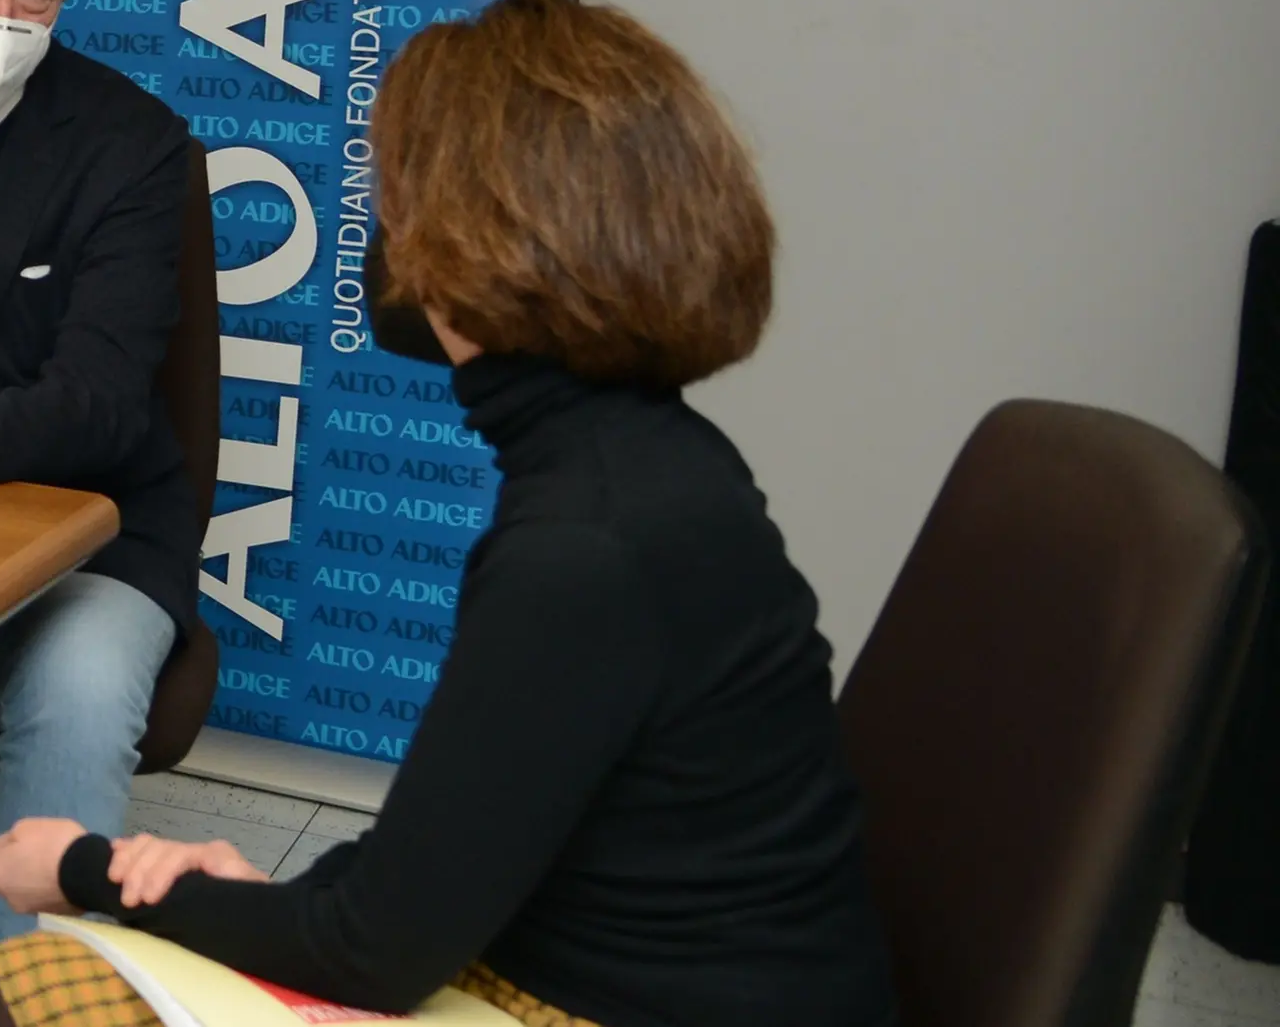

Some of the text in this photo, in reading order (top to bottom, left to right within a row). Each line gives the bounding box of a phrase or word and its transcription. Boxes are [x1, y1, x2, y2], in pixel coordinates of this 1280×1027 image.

[330, 140, 374, 354] QUOTIDIANO
[197, 145, 318, 642] ALTO
[324, 409, 393, 436] ALTO
[320, 448, 485, 488] ALTO ADIGE
[318, 488, 483, 528] ALTO ADIGE
